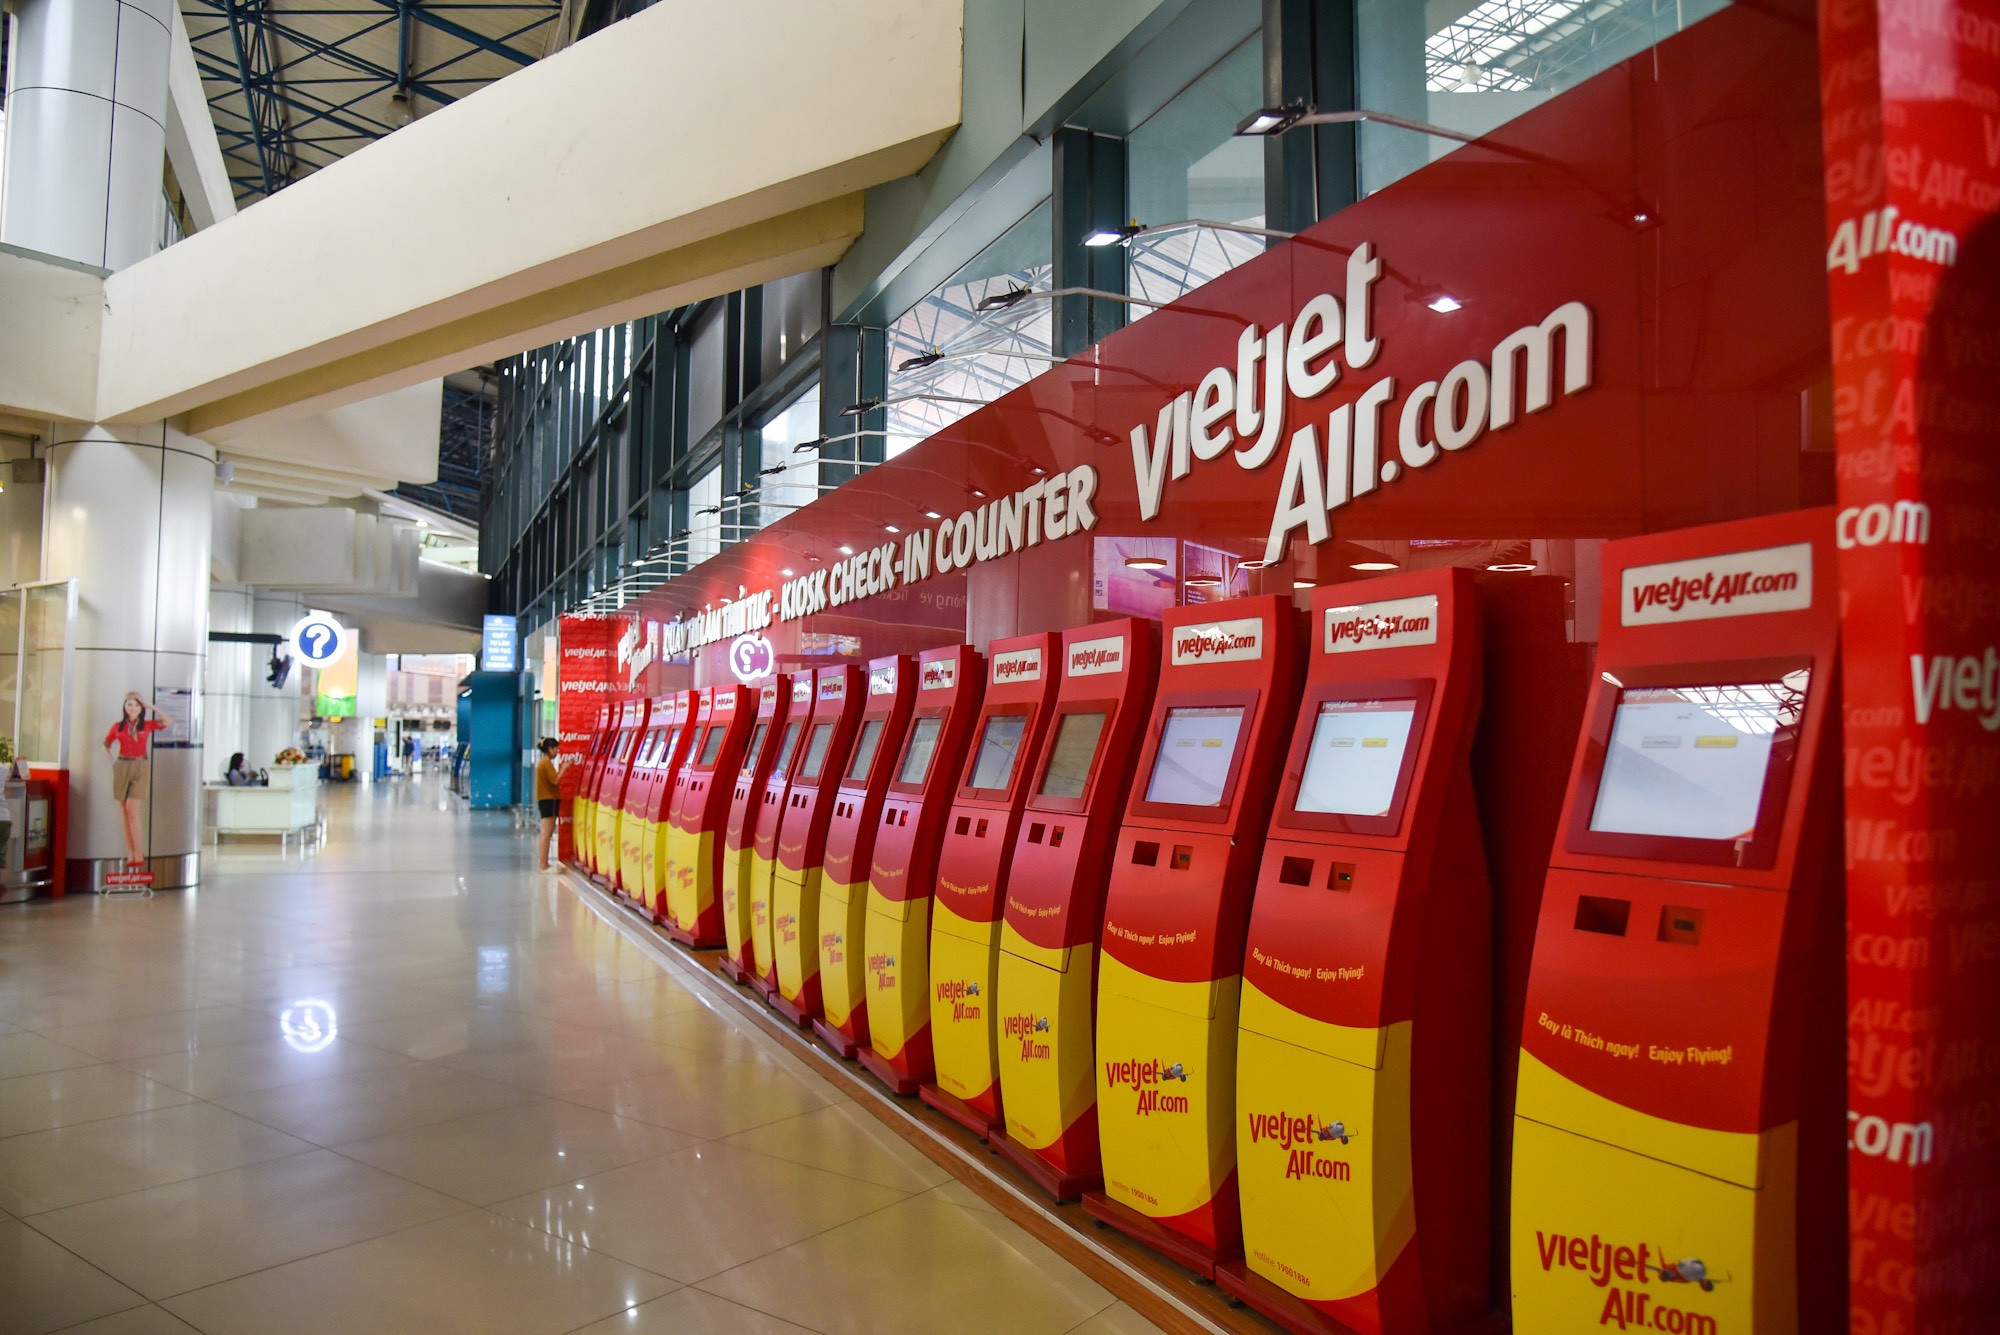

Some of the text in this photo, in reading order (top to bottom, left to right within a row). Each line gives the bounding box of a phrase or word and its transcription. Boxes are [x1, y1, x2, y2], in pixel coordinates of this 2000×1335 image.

[1827, 205, 1957, 274] Air.com
[1130, 241, 1382, 523] Vietjet
[1264, 301, 1594, 567] Air.com
[780, 568, 828, 622] KIOSK
[829, 526, 931, 608] CHECK-IN
[935, 463, 1099, 574] COUNTER
[1252, 947, 1266, 965] Bay
[1273, 958, 1291, 974] Thích
[1292, 967, 1312, 980] ngay!
[1316, 968, 1337, 982] Enjoy
[1338, 965, 1364, 981] Flying!
[1021, 1039, 1050, 1062] Air.com
[1538, 1012, 1732, 1065] Bay là Thích ngay! Enjoy Flying!
[1106, 1058, 1159, 1092] Vietjet
[1136, 1090, 1188, 1116] Air.com
[1249, 1111, 1315, 1151] Vietjet
[1285, 1149, 1350, 1182] Air.com
[1276, 1261, 1311, 1287] 19001886
[1536, 1230, 1651, 1287] Vietjet
[1600, 1287, 1718, 1335] Air.com
